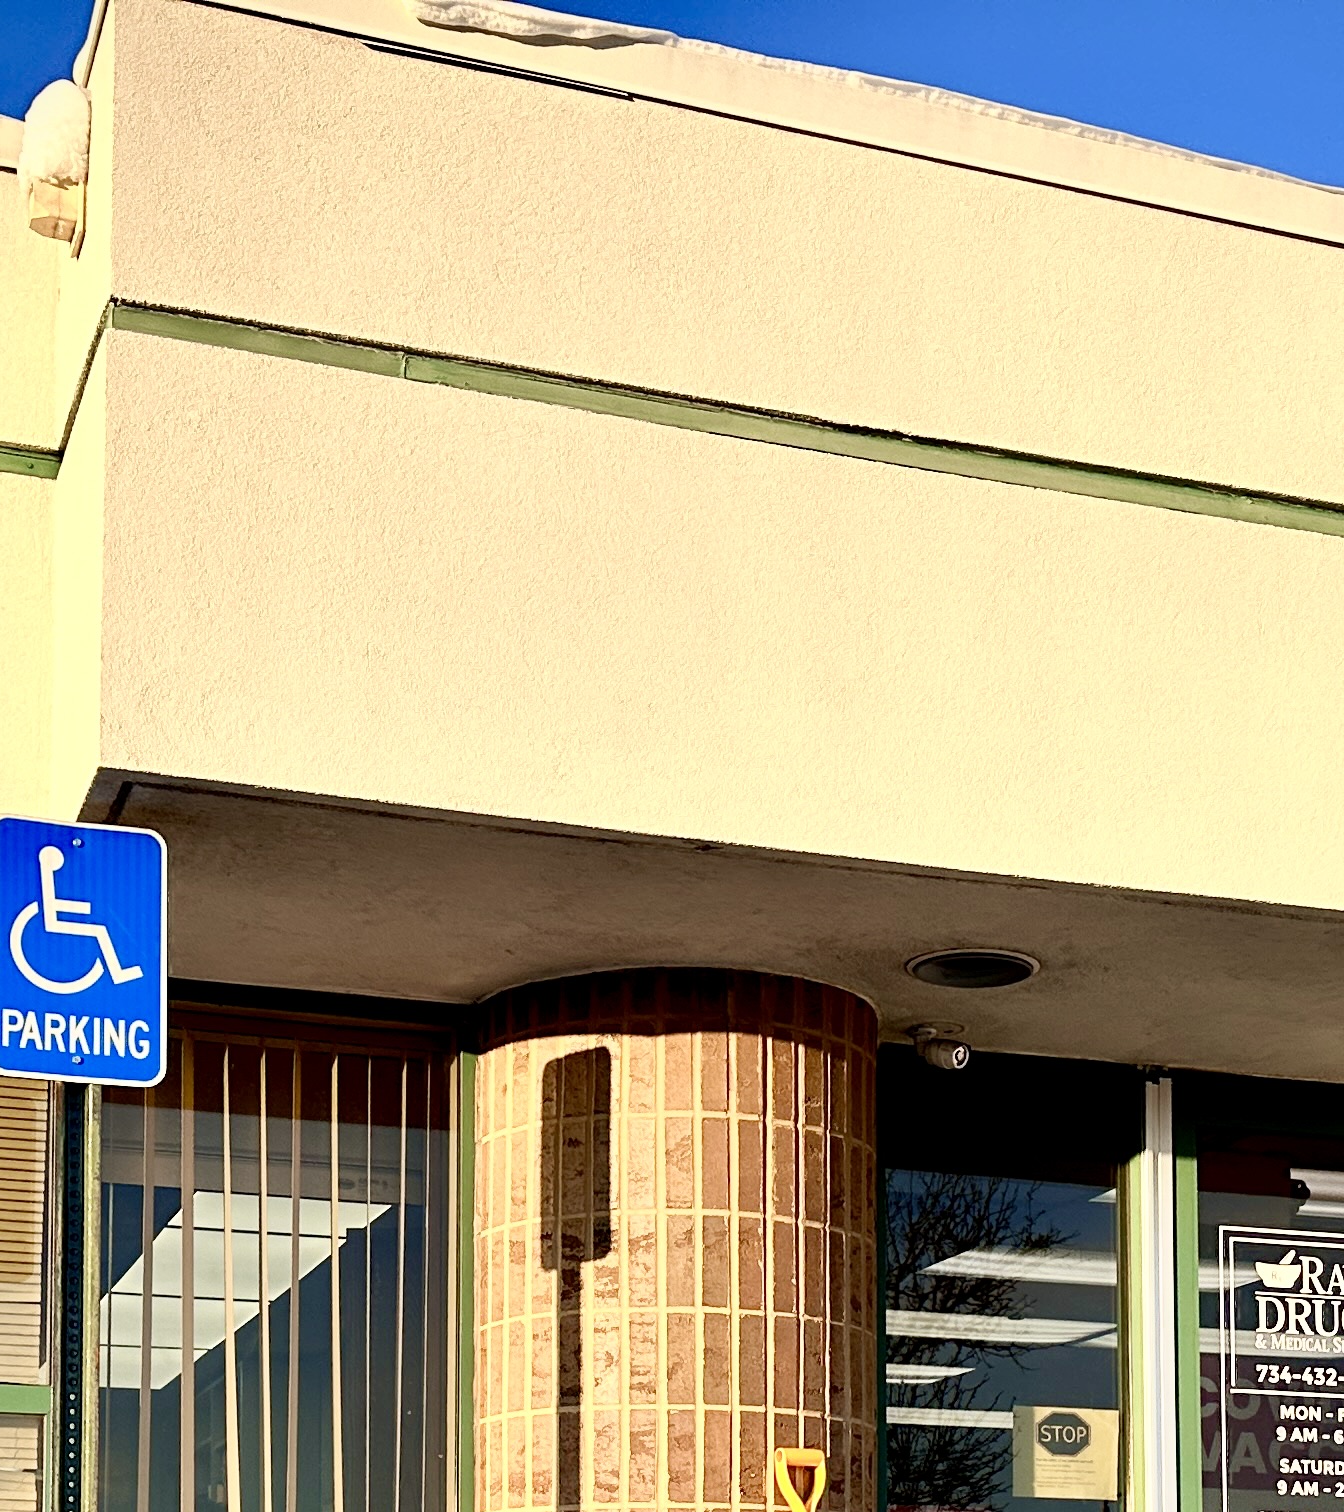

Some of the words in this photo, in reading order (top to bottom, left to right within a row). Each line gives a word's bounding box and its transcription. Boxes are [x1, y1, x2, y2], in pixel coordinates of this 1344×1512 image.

[1, 1008, 150, 1060] PARKING
[1255, 1334, 1267, 1350] &
[1270, 1334, 1331, 1353] MEDICAL
[1279, 1405, 1322, 1422] MON
[1040, 1425, 1087, 1444] STOP
[1275, 1426, 1287, 1442] 9
[1289, 1427, 1318, 1443] AM
[1333, 1429, 1344, 1445] 6
[1276, 1480, 1288, 1496] 9
[1291, 1481, 1319, 1497] AM
